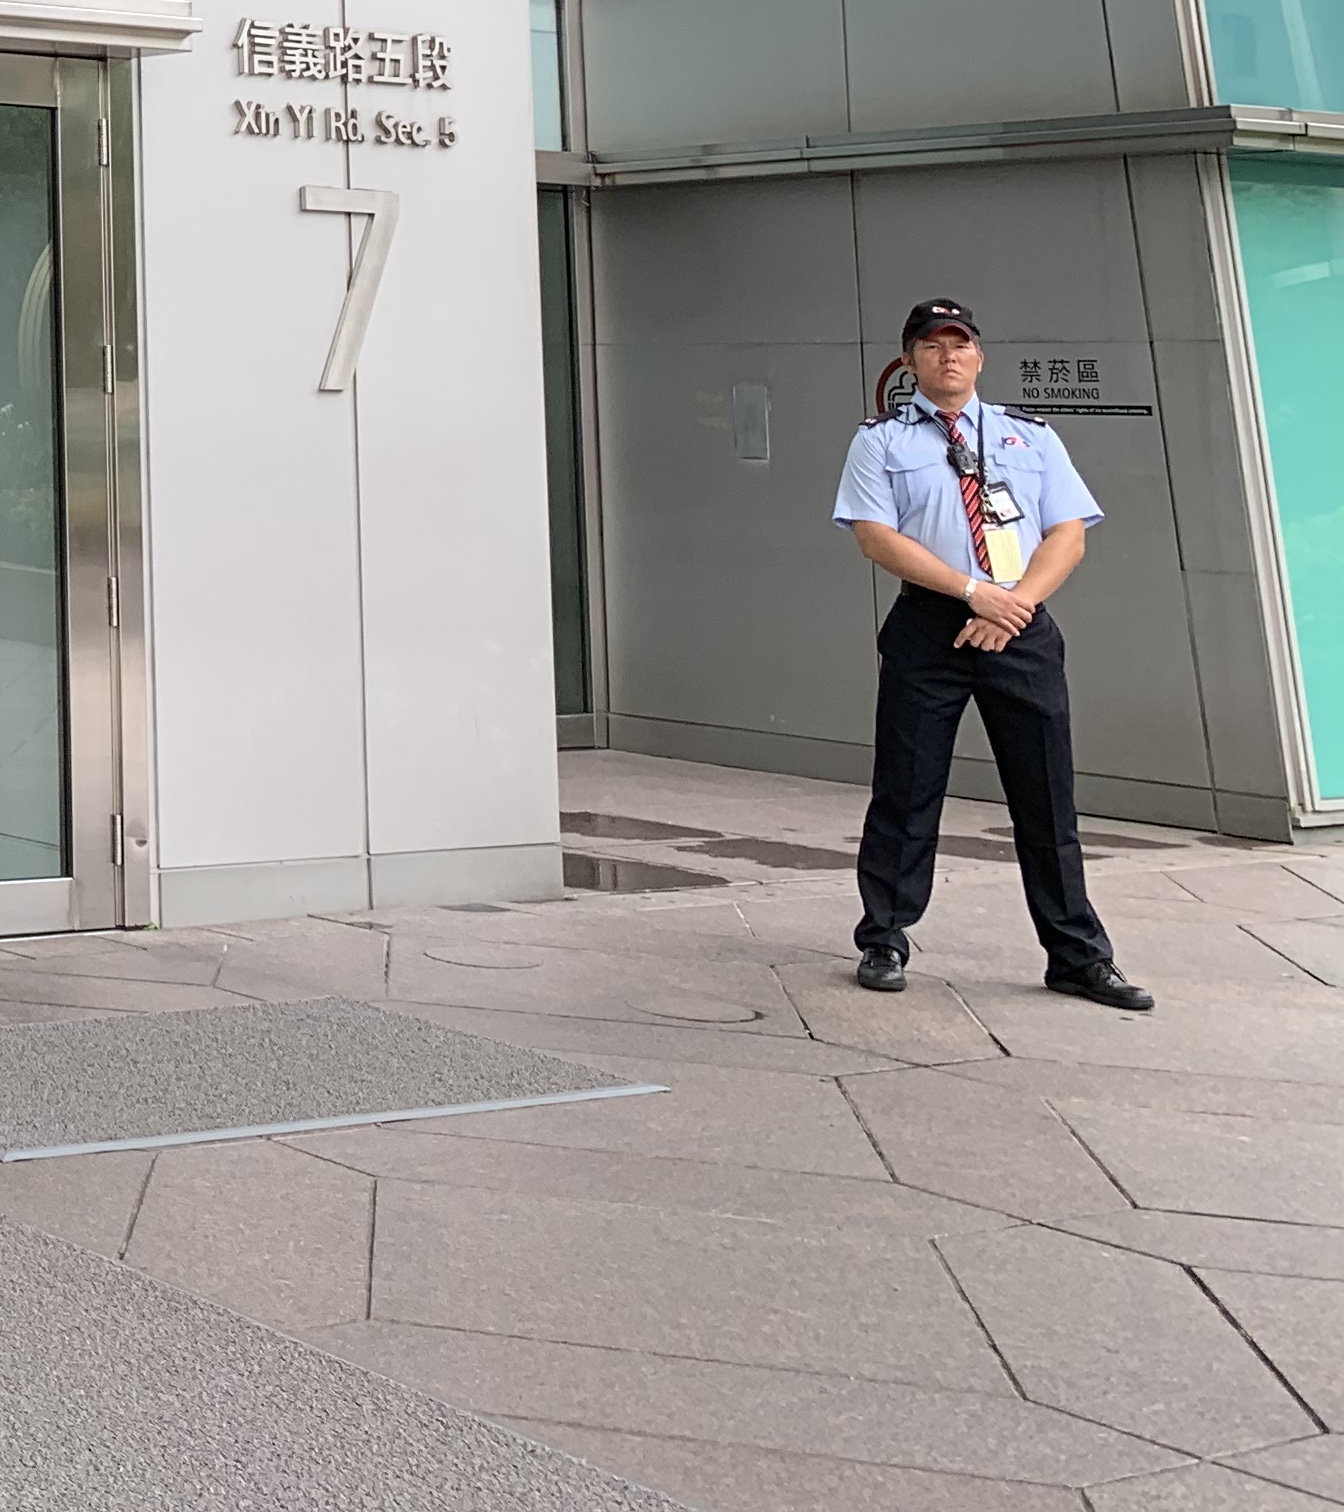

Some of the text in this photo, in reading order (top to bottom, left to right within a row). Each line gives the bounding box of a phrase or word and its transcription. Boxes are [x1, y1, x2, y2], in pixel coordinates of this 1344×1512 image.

[233, 17, 452, 89] 信義路五段
[235, 99, 460, 148] Xin Yi Rd. Sec. 5
[299, 185, 400, 393] 7
[1019, 358, 1100, 383] 禁菸區
[1022, 387, 1100, 400] NO SMOKING
